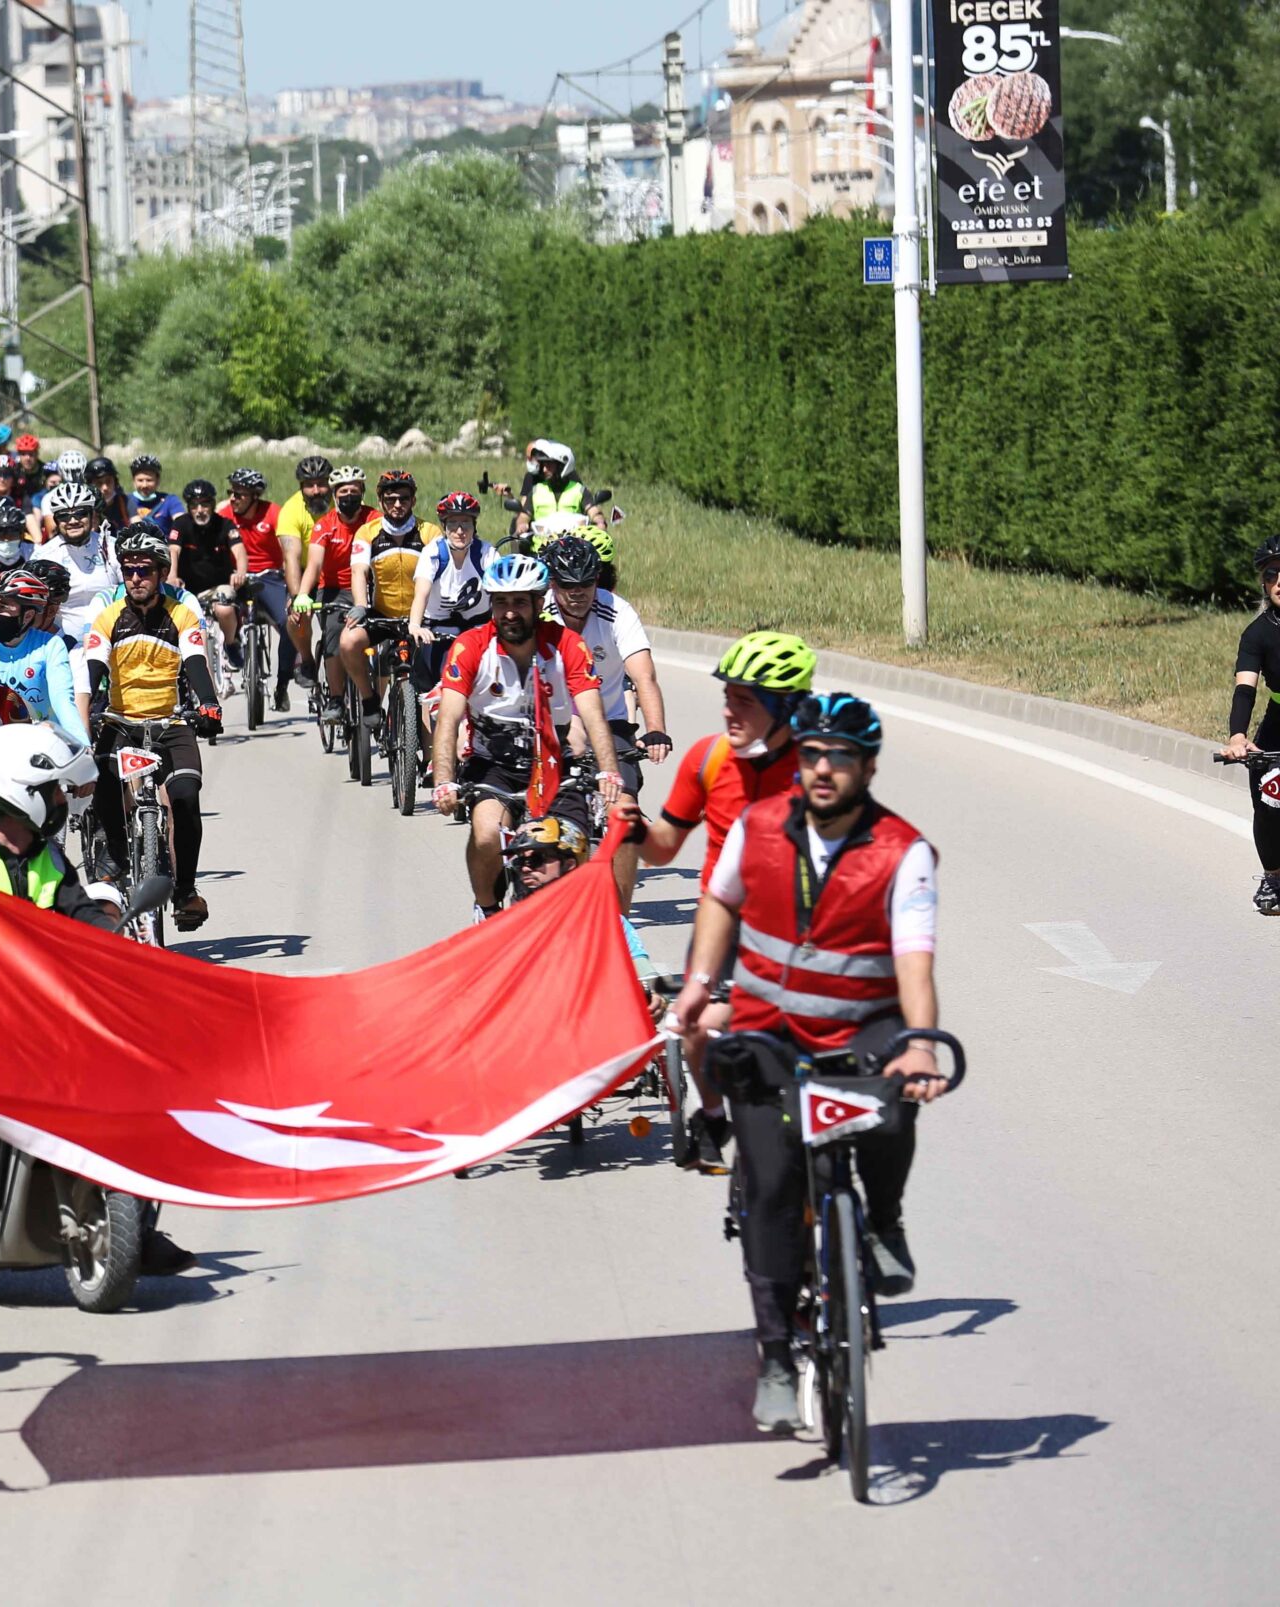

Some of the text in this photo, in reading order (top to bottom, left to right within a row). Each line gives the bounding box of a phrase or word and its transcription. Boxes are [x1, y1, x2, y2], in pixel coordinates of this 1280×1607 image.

[950, 0, 1043, 26] İÇECEK
[961, 23, 1052, 74] 85 TL
[958, 175, 1043, 203] efe et
[951, 218, 984, 232] 0224
[988, 218, 1013, 230] 502
